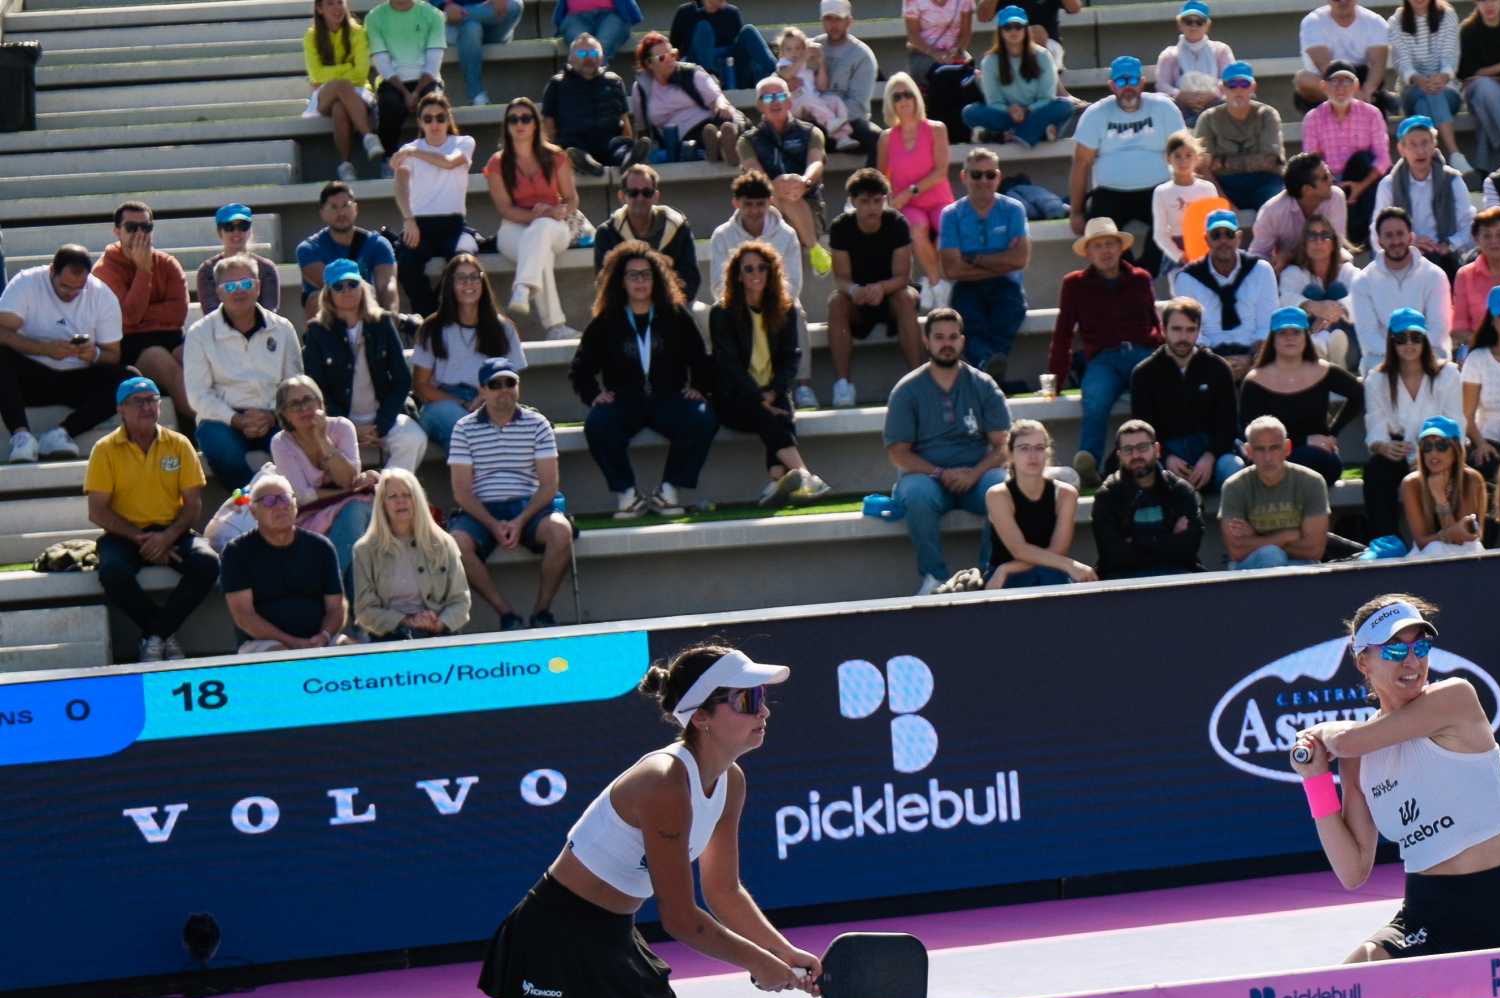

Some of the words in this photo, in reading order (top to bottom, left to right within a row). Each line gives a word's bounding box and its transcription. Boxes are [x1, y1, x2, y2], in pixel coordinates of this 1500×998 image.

[172, 680, 229, 712] 18
[302, 661, 541, 696] Costantino/Rodino
[1276, 685, 1369, 707] CENTRAL
[123, 768, 568, 843] VOLVO
[775, 770, 1022, 861] picklebull
